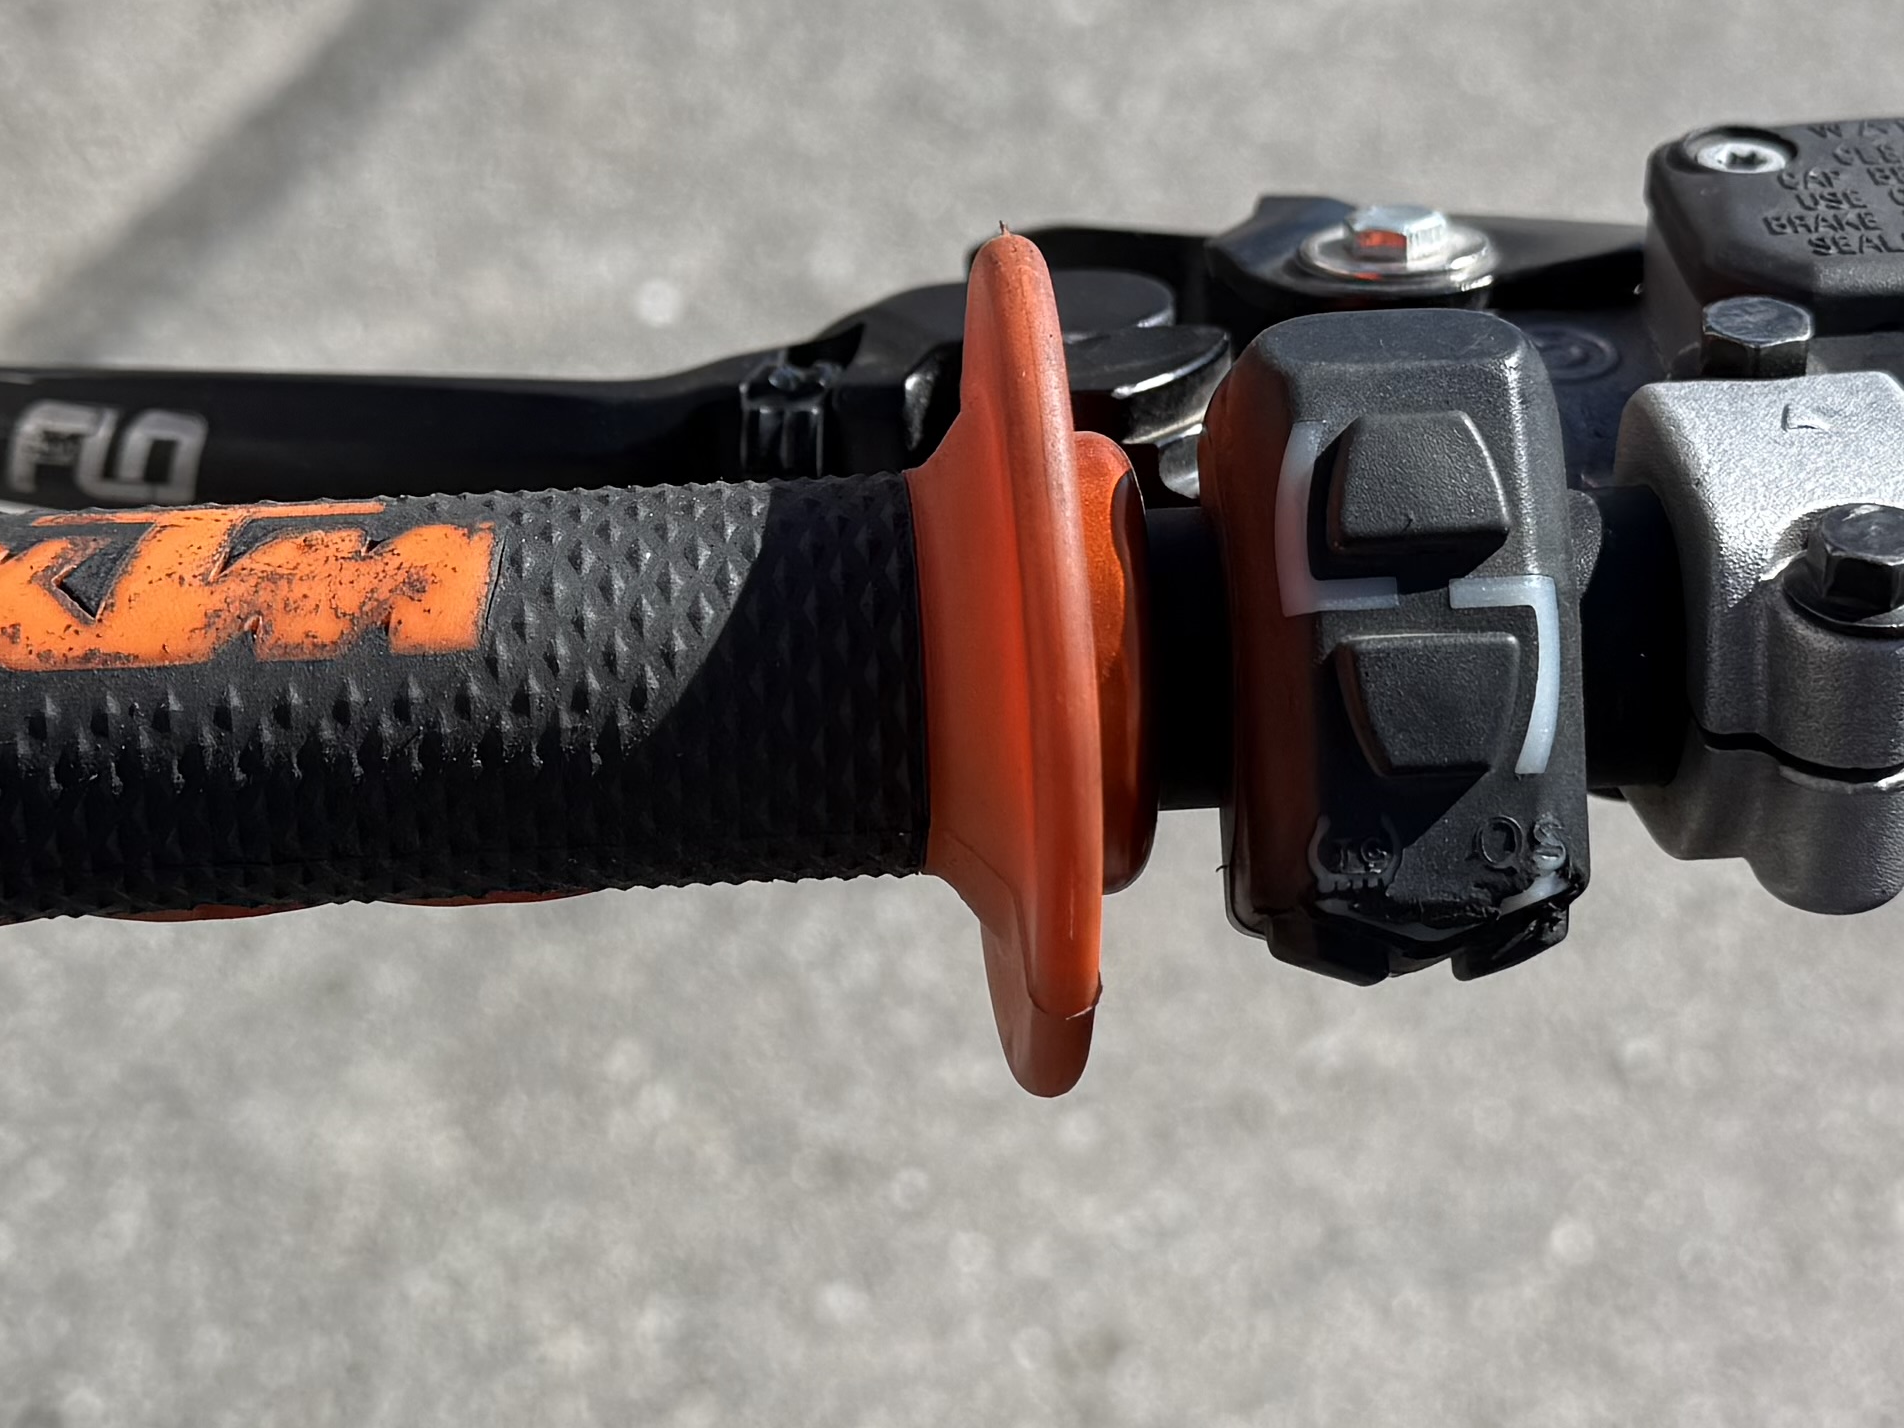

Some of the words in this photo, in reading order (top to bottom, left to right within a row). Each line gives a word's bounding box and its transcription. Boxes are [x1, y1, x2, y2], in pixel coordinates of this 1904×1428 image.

[1776, 169, 1842, 192] CAP
[1795, 189, 1869, 212] USE
[1762, 211, 1883, 237] BRAKE
